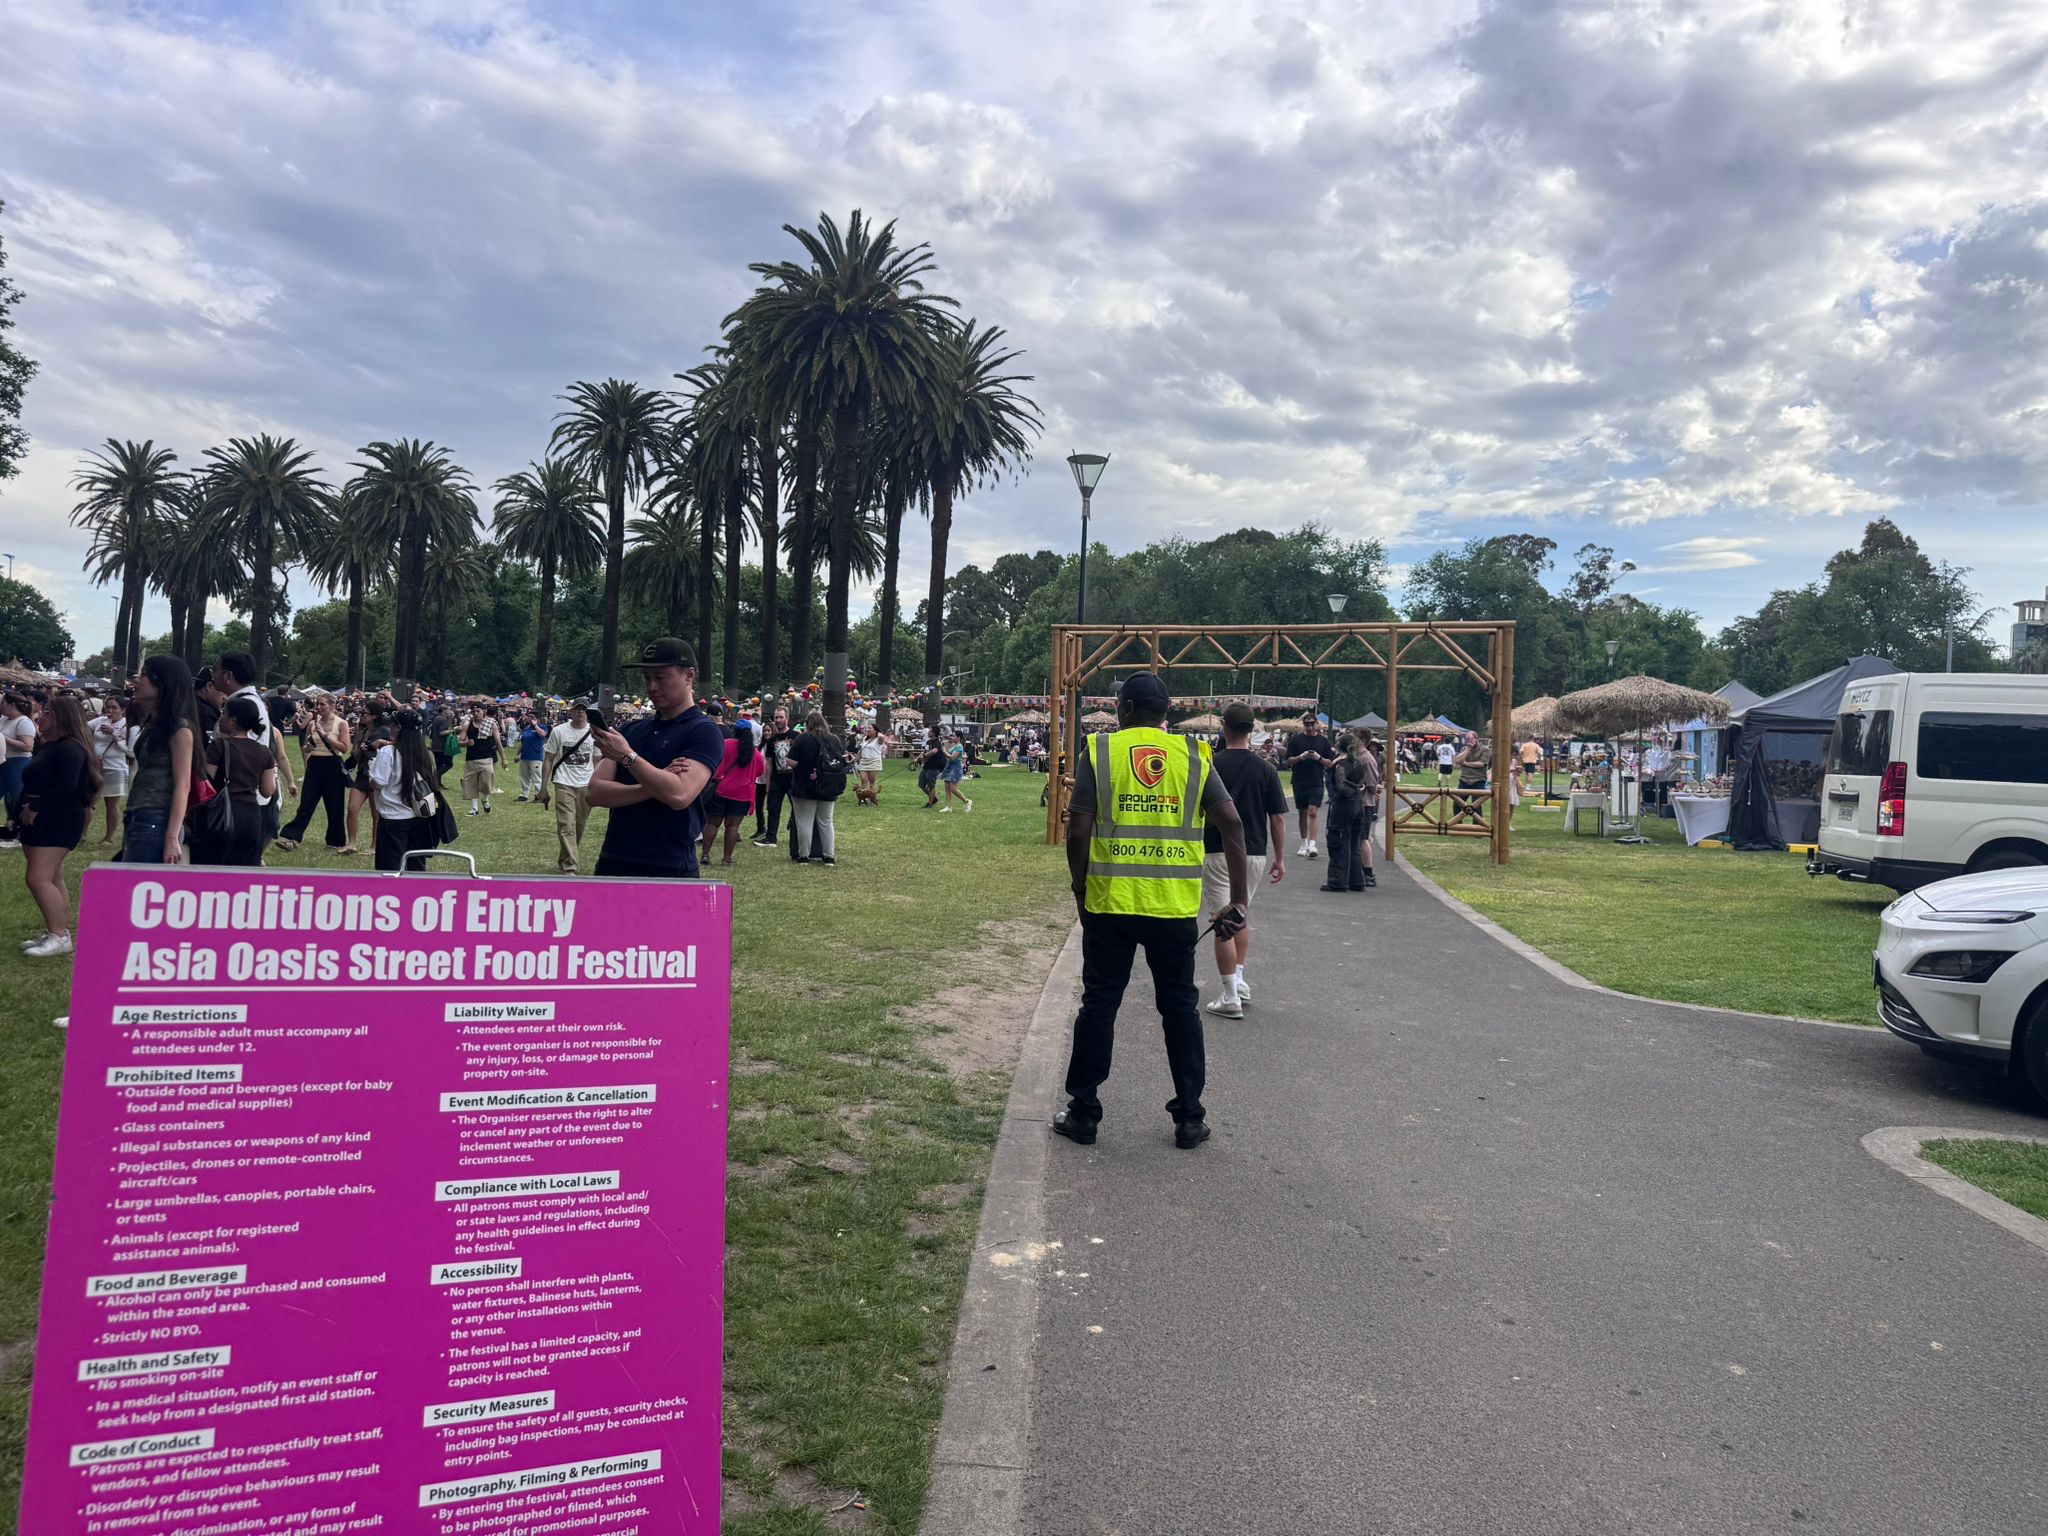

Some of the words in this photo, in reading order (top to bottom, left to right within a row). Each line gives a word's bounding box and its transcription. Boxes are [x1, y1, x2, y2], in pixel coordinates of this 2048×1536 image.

[1119, 804, 1179, 813] SECURITY
[1139, 845, 1164, 857] 476
[1166, 846, 1185, 858] 876
[131, 882, 400, 931] Conditions
[412, 890, 457, 932] of
[466, 891, 576, 937] Entry
[122, 942, 216, 980] Asia
[228, 942, 339, 980] Oasis
[349, 944, 466, 980] Street
[474, 945, 558, 980] Food
[568, 945, 696, 979] Festival
[120, 1011, 149, 1024] Age
[153, 1009, 237, 1021] Restrictions
[455, 1007, 503, 1019] Liability
[506, 1006, 547, 1016] Waiver
[132, 1030, 140, 1039] A
[144, 1028, 216, 1040] responsible
[220, 1027, 251, 1037] adult
[254, 1028, 284, 1036] must
[286, 1028, 352, 1038] accompany
[354, 1026, 368, 1035] all
[463, 1025, 514, 1034] Attendees
[558, 1024, 581, 1032] their
[606, 1022, 625, 1030] risk.
[132, 1044, 195, 1054] attendees
[198, 1043, 234, 1052] under
[240, 1042, 256, 1052] 12.
[462, 1043, 480, 1051] The
[483, 1043, 511, 1051] event
[514, 1041, 561, 1052] organiser
[563, 1040, 570, 1048] is
[592, 1038, 646, 1049] responsible
[649, 1037, 662, 1045] for
[467, 1058, 485, 1066] any
[488, 1056, 519, 1065] injury,
[522, 1055, 544, 1063] loss,
[559, 1053, 598, 1062] damage
[613, 1050, 653, 1061] personal
[115, 1070, 192, 1082] Prohibited
[196, 1070, 235, 1080] Items
[125, 1086, 175, 1097] Outside
[178, 1085, 207, 1095] food
[210, 1084, 233, 1094] and
[237, 1084, 298, 1094] beverages
[301, 1083, 343, 1093] (except
[346, 1081, 362, 1090] for
[365, 1080, 392, 1090] baby
[128, 1102, 157, 1112] food
[160, 1101, 184, 1111] and
[187, 1099, 236, 1110] medical
[239, 1097, 292, 1110] supplies)
[450, 1097, 484, 1107] Event
[487, 1094, 562, 1105] Modification
[566, 1093, 574, 1102] &
[578, 1090, 649, 1102] Cancellation
[458, 1115, 477, 1124] The
[479, 1114, 529, 1125] Organiser
[575, 1110, 591, 1119] the
[593, 1109, 616, 1119] right
[631, 1107, 652, 1116] alter
[122, 1122, 156, 1132] Glass
[159, 1120, 224, 1131] containers
[460, 1142, 510, 1151] inclement
[513, 1139, 554, 1148] weather
[569, 1136, 623, 1145] unforeseen
[459, 1155, 534, 1165] circumstances.
[120, 1176, 197, 1188] aircraft/cars
[445, 1183, 517, 1196] Compliance
[520, 1179, 546, 1190] with
[550, 1176, 580, 1188] Local
[584, 1176, 611, 1186] Laws
[454, 1203, 468, 1212] All
[470, 1203, 510, 1213] patrons
[512, 1200, 538, 1208] must
[540, 1196, 576, 1207] comply
[578, 1194, 600, 1203] with
[602, 1192, 624, 1202] local
[627, 1191, 648, 1200] and/
[455, 1245, 472, 1254] the
[475, 1241, 515, 1252] festival.
[441, 1263, 517, 1279] Accessibility
[95, 1277, 133, 1291] Food
[137, 1274, 165, 1288] and
[170, 1272, 238, 1285] Beverage
[450, 1288, 465, 1296] No
[467, 1285, 503, 1297] person
[506, 1280, 529, 1291] shall
[532, 1277, 576, 1288] interfere
[578, 1274, 599, 1284] with
[602, 1272, 634, 1284] plants,
[102, 1330, 148, 1343] Strictly
[150, 1328, 170, 1338] NO
[173, 1325, 201, 1336] BYO.
[451, 1330, 468, 1339] the
[471, 1327, 505, 1336] venue.
[87, 1359, 136, 1374] Health
[141, 1355, 169, 1369] and
[174, 1352, 219, 1365] Safety
[98, 1379, 117, 1390] No
[120, 1373, 176, 1388] smoking
[180, 1367, 224, 1381] on-site
[448, 1374, 493, 1387] capacity
[496, 1372, 503, 1381] is
[506, 1366, 550, 1379] reached.
[434, 1404, 486, 1420] Security
[490, 1397, 548, 1412] Measures
[443, 1428, 455, 1437] To
[458, 1424, 494, 1435] ensure
[496, 1420, 513, 1430] the
[516, 1416, 547, 1427] safety
[549, 1412, 560, 1422] of
[562, 1411, 574, 1421] all
[576, 1408, 611, 1421] guests,
[614, 1402, 652, 1414] security
[654, 1397, 688, 1408] checks,
[78, 1445, 117, 1460] Code
[120, 1441, 136, 1455] of
[139, 1435, 200, 1452] Conduct
[90, 1462, 141, 1476] Patrons
[144, 1459, 166, 1469] are
[168, 1448, 228, 1466] expected
[232, 1448, 244, 1457] to
[248, 1436, 320, 1454] respectfully
[323, 1433, 352, 1444] treat
[355, 1427, 383, 1440] staff,
[444, 1456, 473, 1467] entry
[476, 1451, 512, 1464] points.
[430, 1479, 516, 1500] Photography,
[520, 1472, 567, 1489] Filming
[569, 1468, 578, 1478] &
[581, 1459, 648, 1477] Performing
[439, 1509, 453, 1520] By
[456, 1502, 503, 1516] entering
[506, 1497, 524, 1508] the
[526, 1489, 568, 1504] festival,
[571, 1483, 622, 1497] attendees
[624, 1475, 664, 1488] consent
